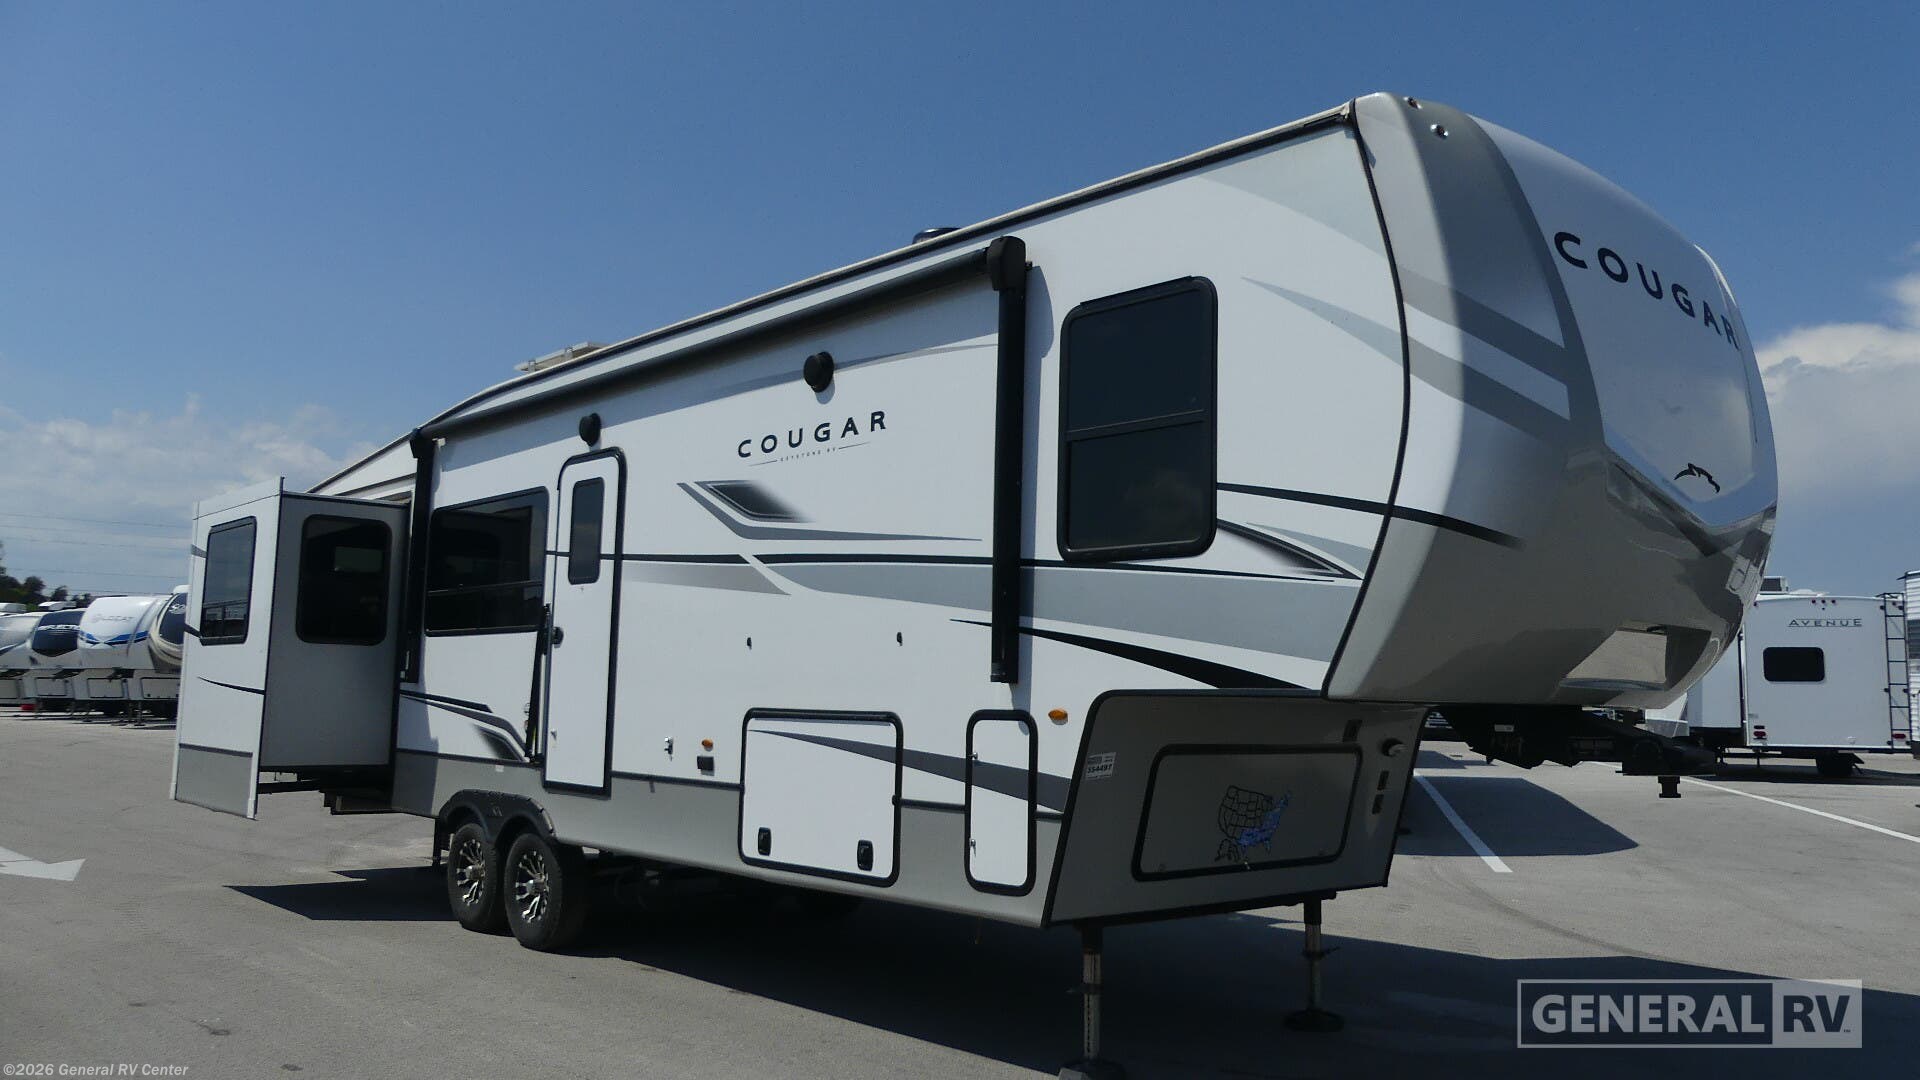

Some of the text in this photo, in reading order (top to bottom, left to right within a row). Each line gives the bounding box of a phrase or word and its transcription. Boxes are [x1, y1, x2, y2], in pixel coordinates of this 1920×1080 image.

[1553, 231, 1740, 351] COUGAR
[737, 410, 887, 458] COUGAR
[1788, 618, 1863, 628] AVENUE
